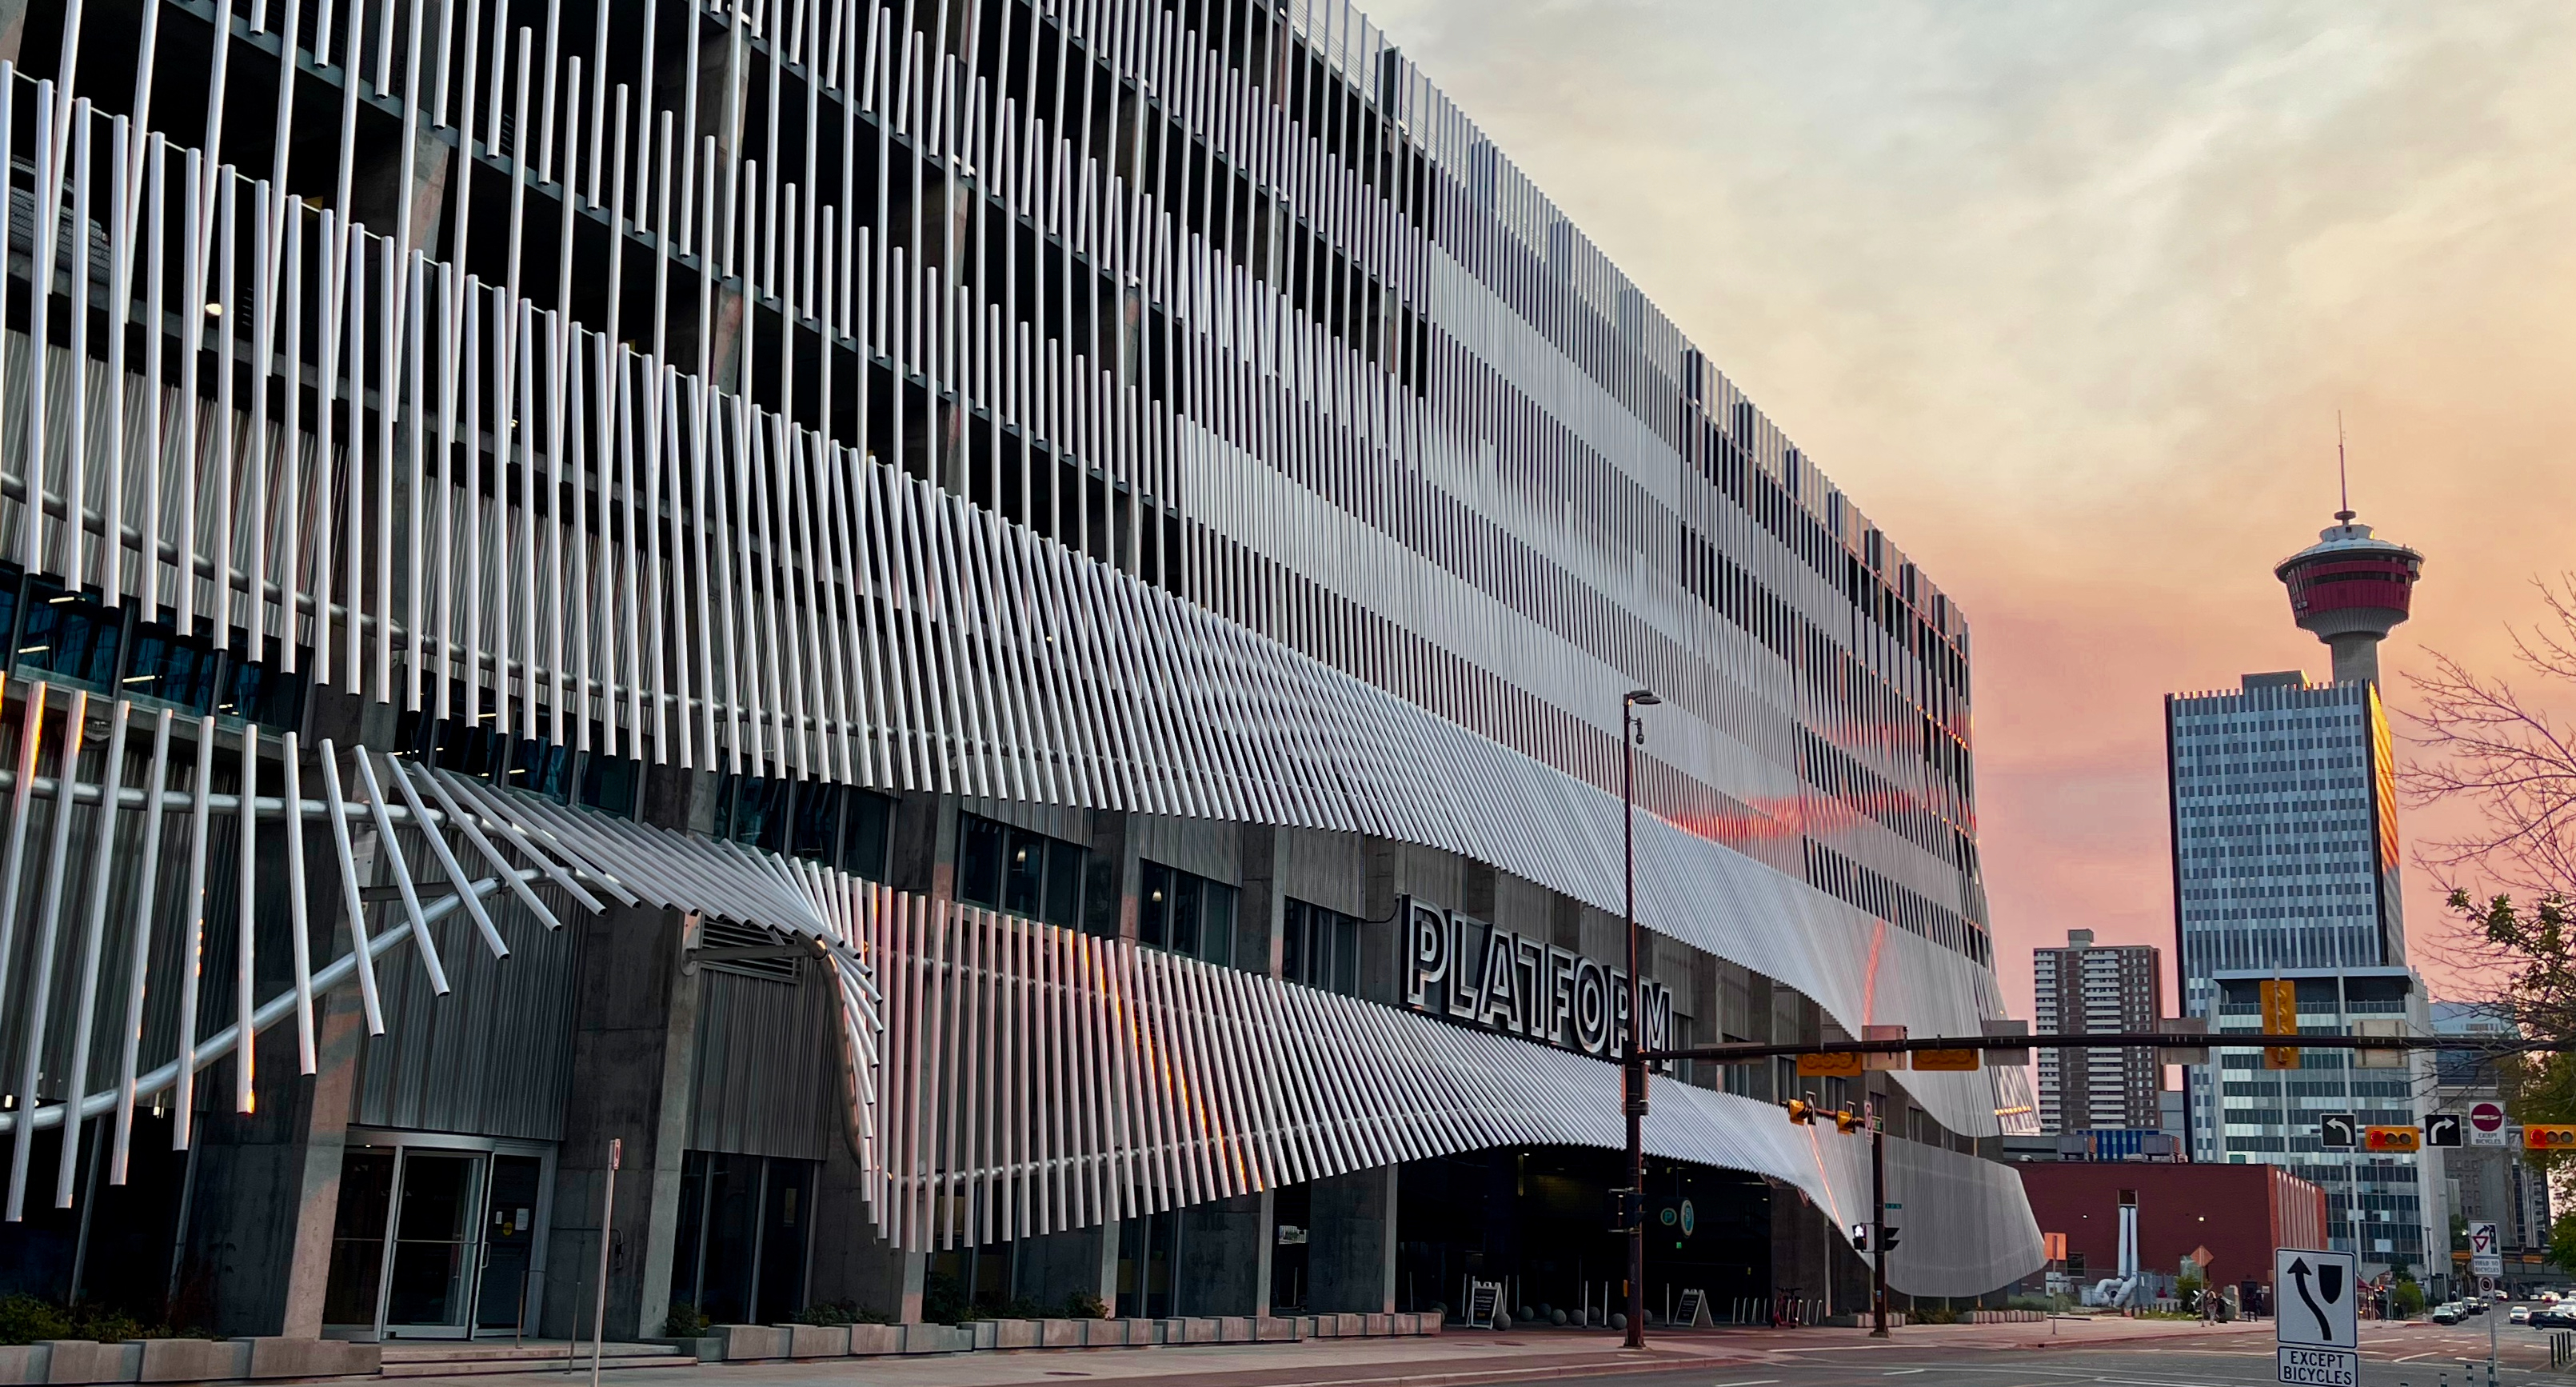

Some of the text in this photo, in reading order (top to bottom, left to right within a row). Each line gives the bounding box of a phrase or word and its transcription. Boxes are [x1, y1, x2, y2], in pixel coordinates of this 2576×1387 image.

[1402, 894, 1673, 1072] PLATFORM
[1664, 1212, 1672, 1221] P
[2290, 1351, 2344, 1368] EXCEPT
[2283, 1366, 2352, 1385] BICYCLES
